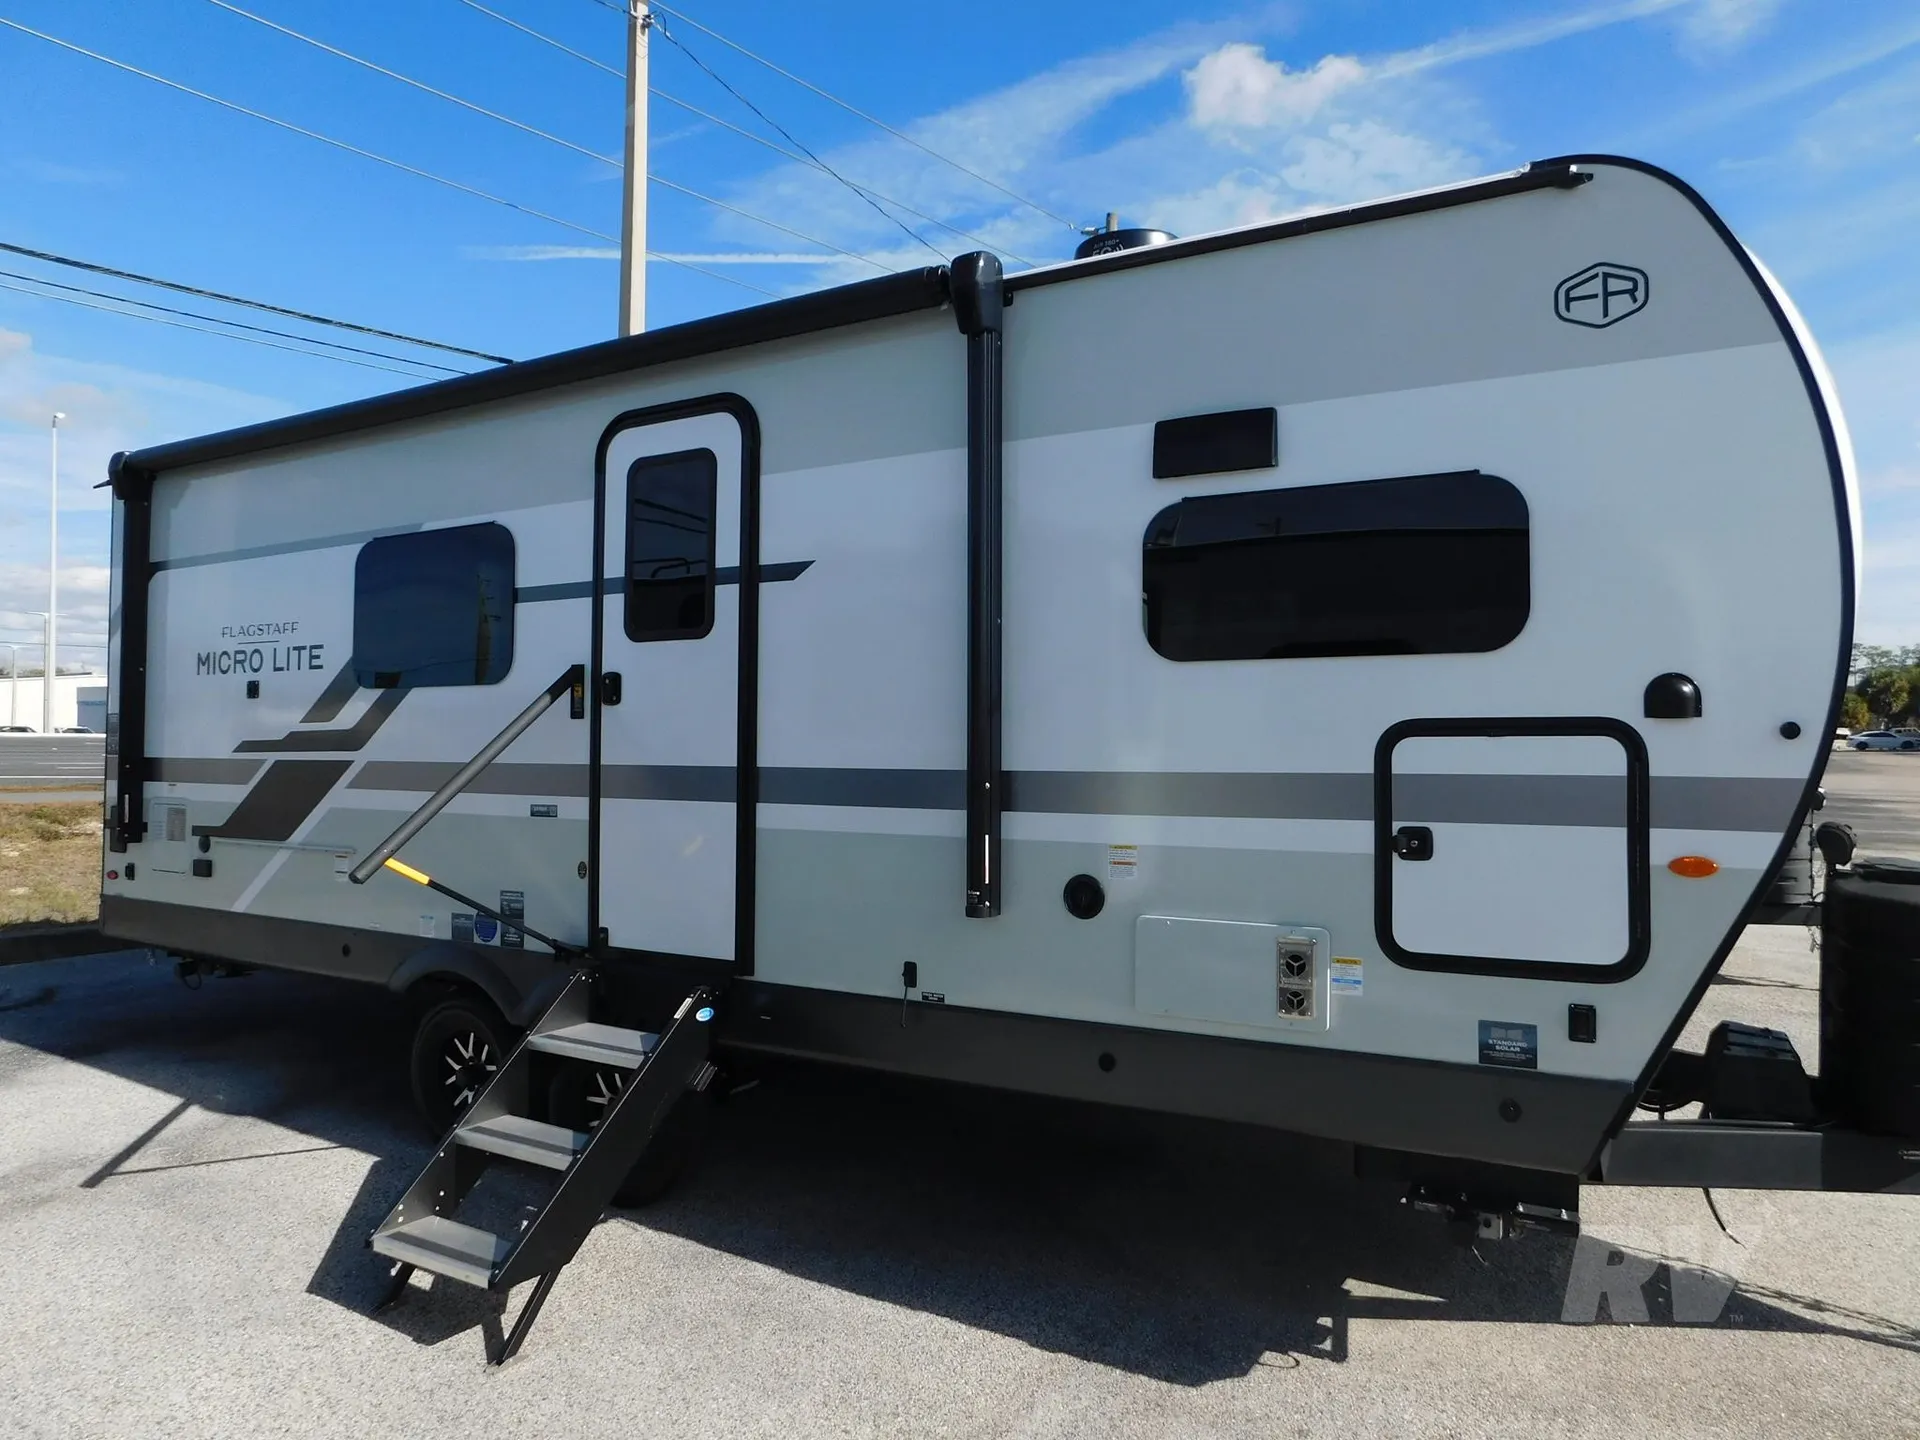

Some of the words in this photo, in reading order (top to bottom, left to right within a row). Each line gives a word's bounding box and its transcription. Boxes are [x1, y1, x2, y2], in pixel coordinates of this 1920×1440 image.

[1564, 271, 1639, 319] FR
[221, 621, 300, 638] FLAGSTAFF
[196, 648, 264, 675] MICRO
[273, 644, 325, 672] LITE
[1488, 1039, 1528, 1048] STANDARD
